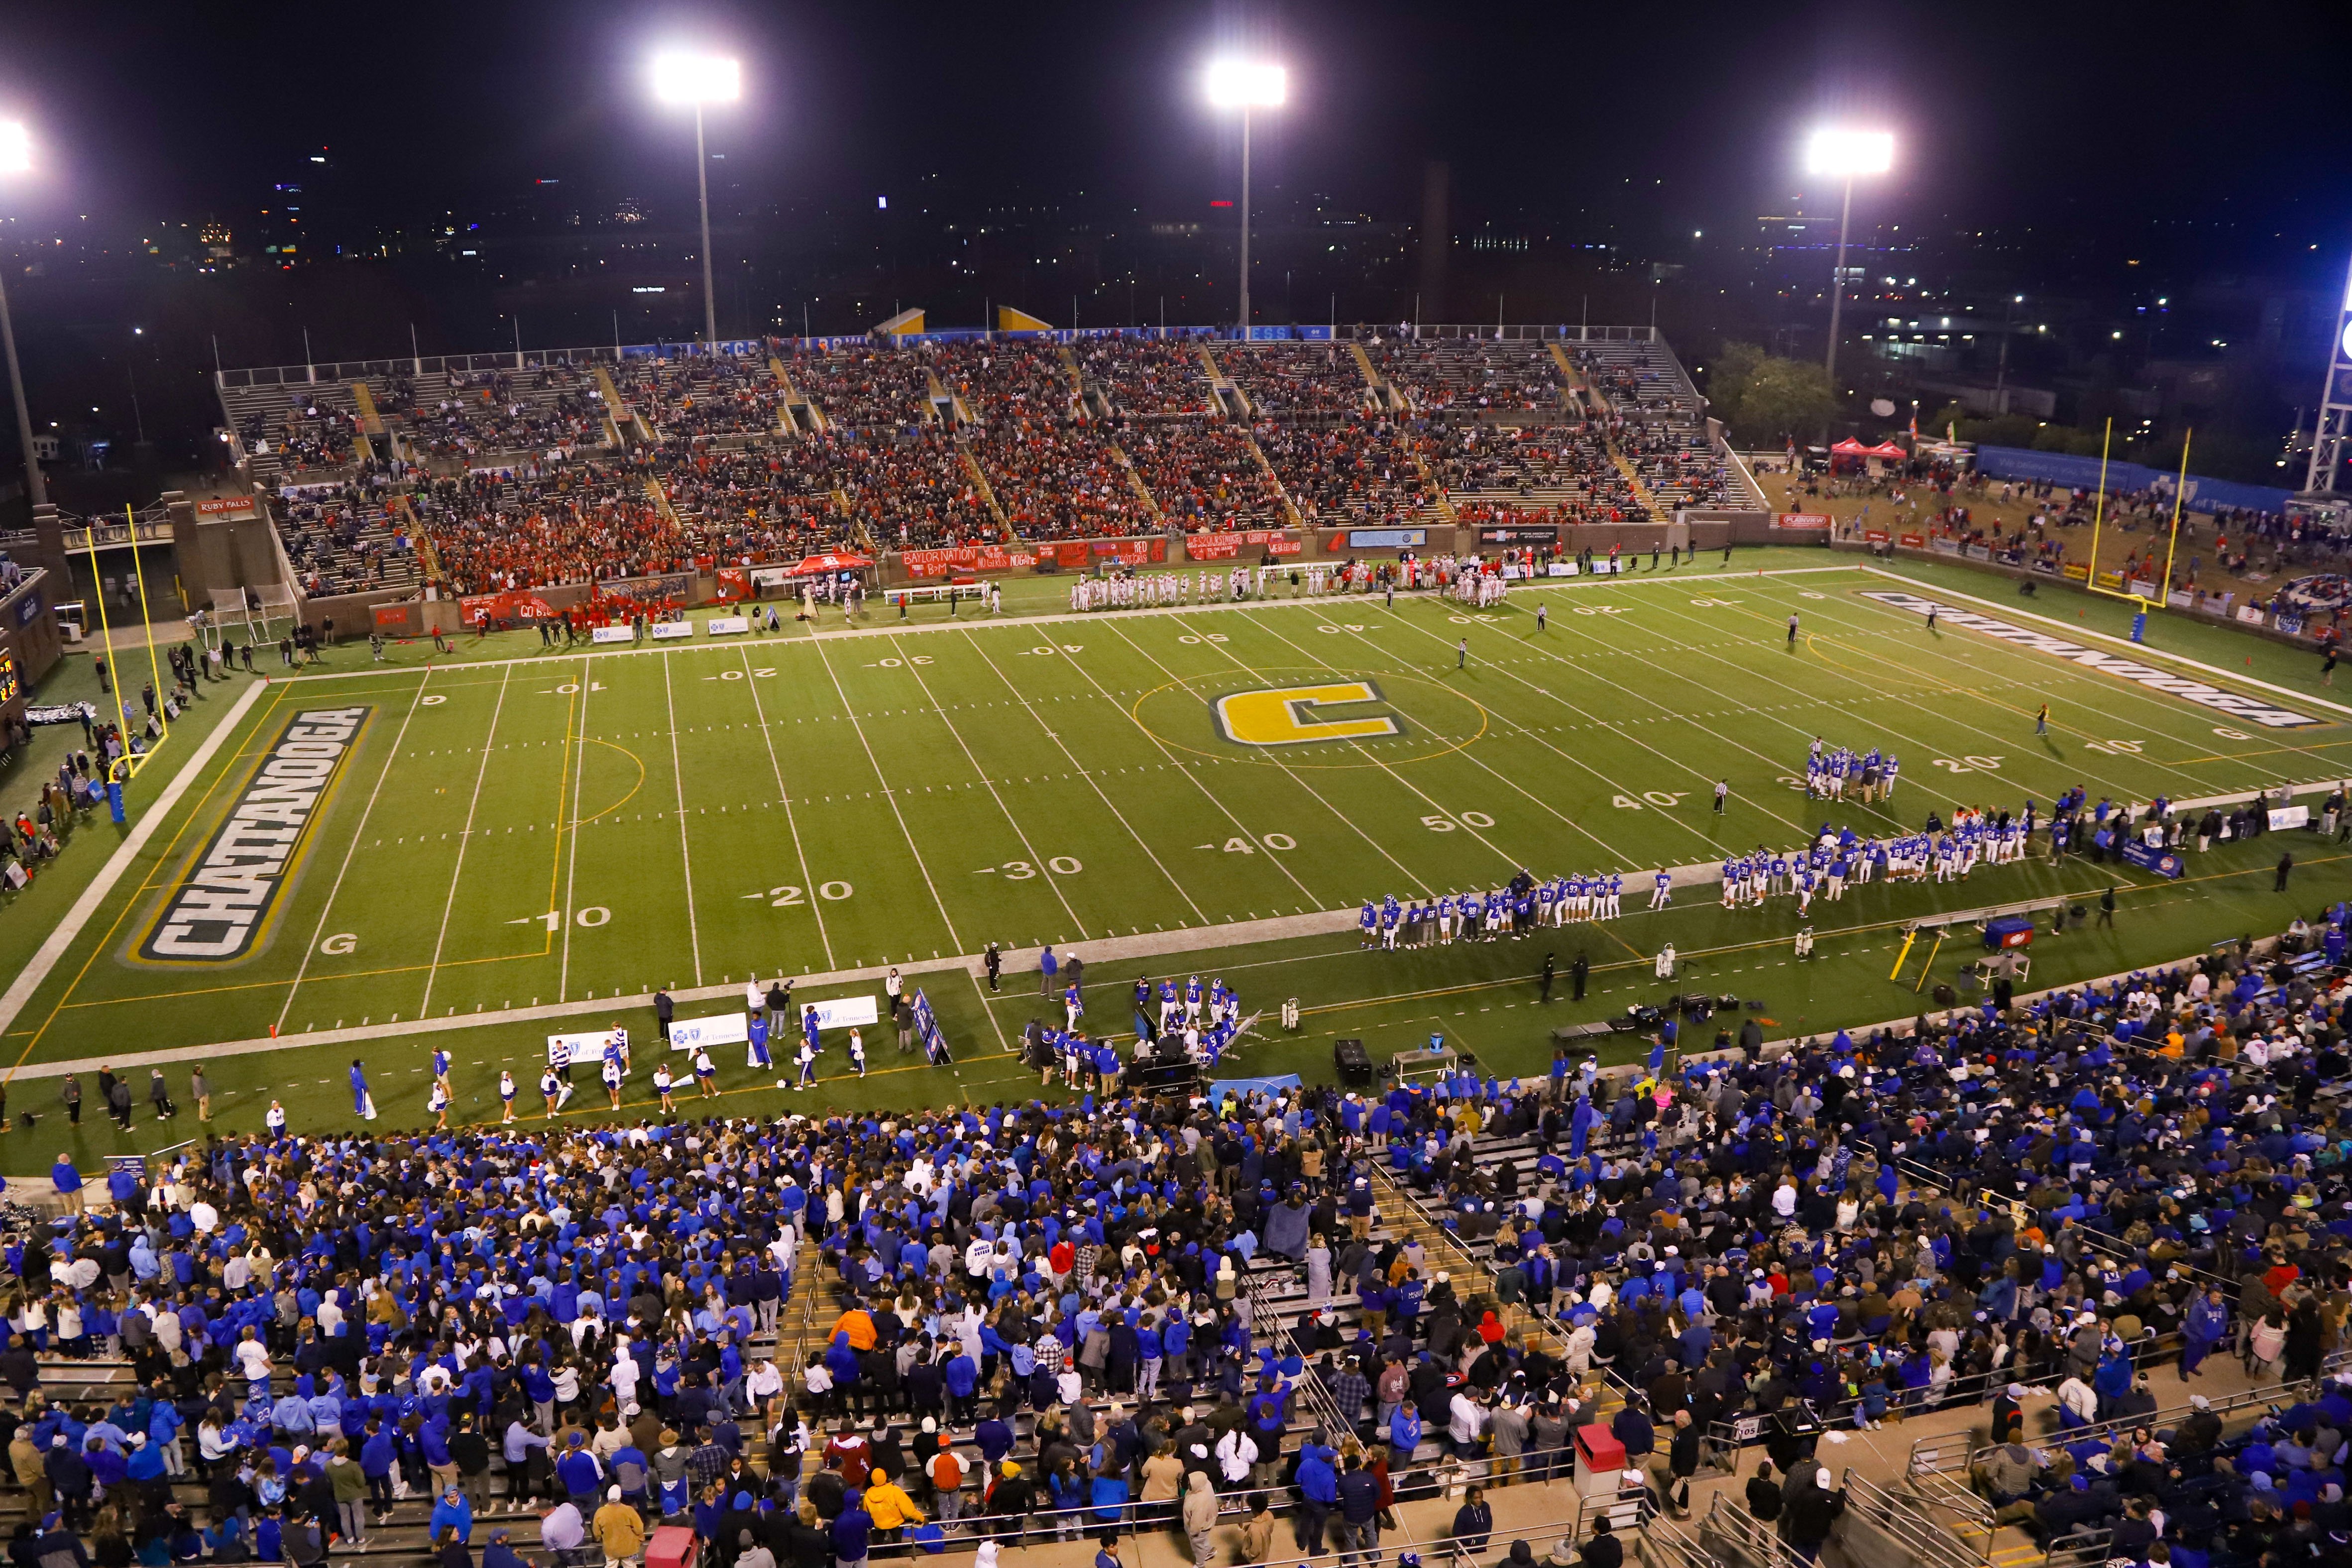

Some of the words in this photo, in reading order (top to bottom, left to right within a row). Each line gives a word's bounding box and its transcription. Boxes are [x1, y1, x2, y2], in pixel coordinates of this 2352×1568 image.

[201, 502, 224, 511] RUBY
[1134, 541, 1147, 553] RED
[903, 552, 939, 564] BAYLOR
[940, 549, 976, 561] NATION
[521, 605, 533, 618] GO
[1449, 614, 1499, 625] 30
[1317, 623, 1365, 634] 40
[1178, 633, 1231, 644] 50
[1031, 644, 1085, 656] 40
[879, 656, 935, 668] 30
[1859, 591, 2318, 726] CHATTANOOGA
[716, 668, 778, 681] 20
[556, 681, 607, 694] 10
[1217, 682, 1399, 745] C
[1932, 756, 2002, 774] 20
[1612, 791, 1681, 810] 40
[1419, 811, 1495, 832] 50
[153, 708, 364, 956] CHATTANOOGA
[1223, 833, 1297, 855] 40
[1002, 856, 1084, 880] 30
[770, 881, 854, 907] 20
[1542, 892, 1551, 900] 73
[1505, 898, 1513, 907] 70
[1444, 906, 1451, 915] 82
[1468, 906, 1477, 915] 88
[536, 906, 611, 932] 10
[1383, 914, 1392, 923] 34
[321, 933, 358, 955] G
[1189, 989, 1197, 998] 71
[841, 1014, 875, 1023] Tennessee
[711, 1031, 745, 1040] Tennessee
[1053, 1033, 1060, 1043] 2
[1083, 1049, 1091, 1060] 16
[257, 1407, 271, 1418] 23
